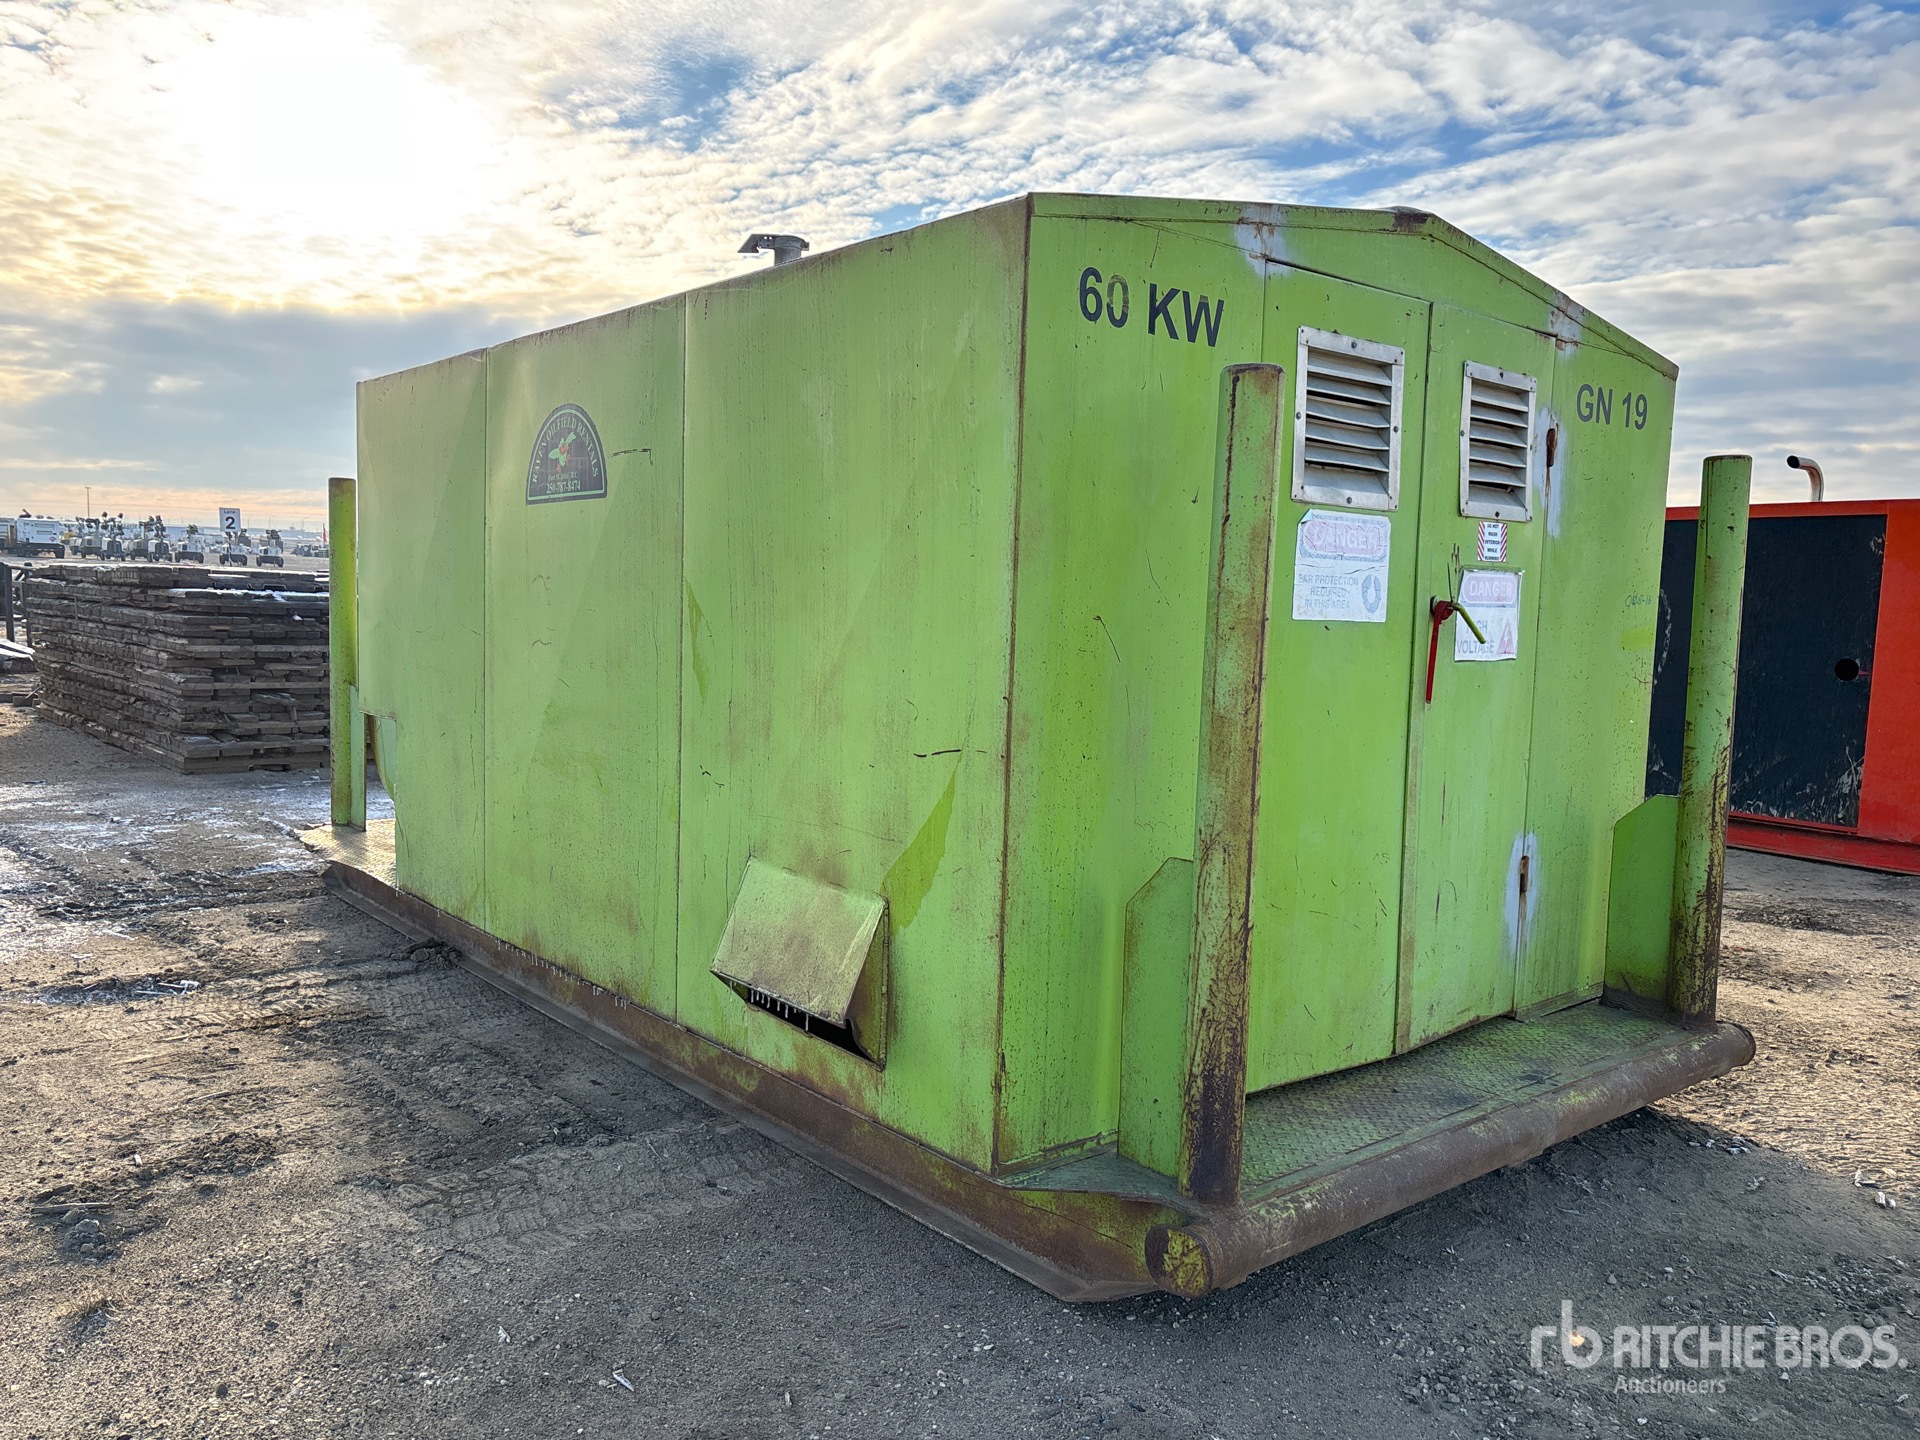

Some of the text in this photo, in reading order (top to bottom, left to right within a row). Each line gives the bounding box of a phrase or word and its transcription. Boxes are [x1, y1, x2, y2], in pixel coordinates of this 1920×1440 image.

[1079, 266, 1225, 348] 60 KW
[1576, 383, 1648, 430] GN 19
[546, 416, 577, 441] OILFIELD
[576, 421, 599, 477] RENTALS
[225, 516, 236, 529] 2
[1315, 574, 1359, 586] PROTECTION
[1310, 587, 1346, 597] REQUIRED
[1469, 580, 1512, 597] DANGER
[1304, 598, 1350, 609] IN THIS AREA
[1456, 640, 1495, 654] VOLTAGE
